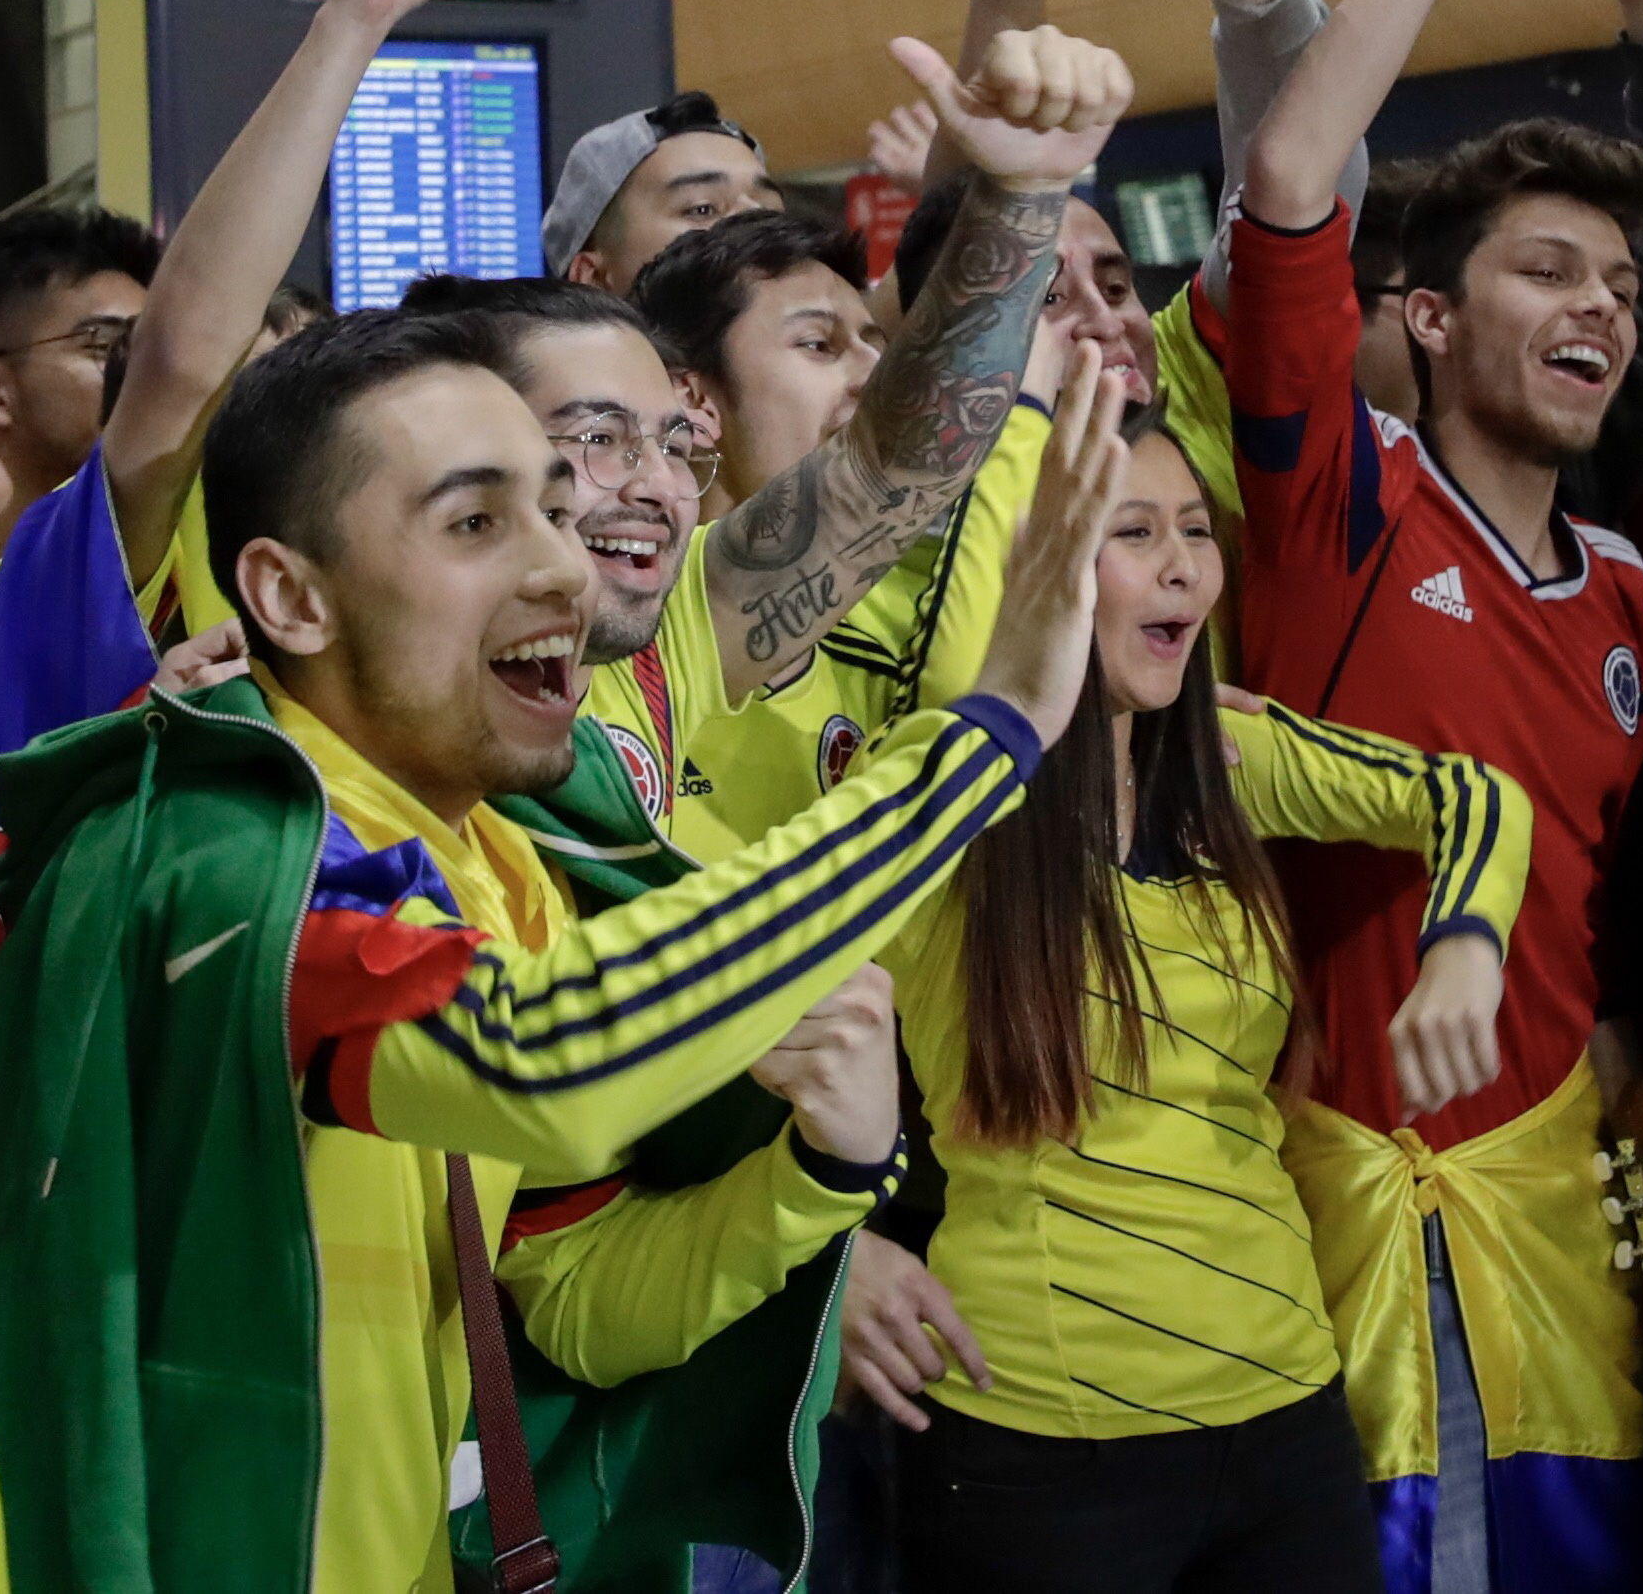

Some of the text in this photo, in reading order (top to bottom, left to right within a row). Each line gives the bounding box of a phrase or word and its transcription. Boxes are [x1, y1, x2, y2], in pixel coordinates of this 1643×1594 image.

[741, 561, 842, 662] Arte
[1411, 585, 1474, 623] adidas
[677, 772, 714, 797] das
